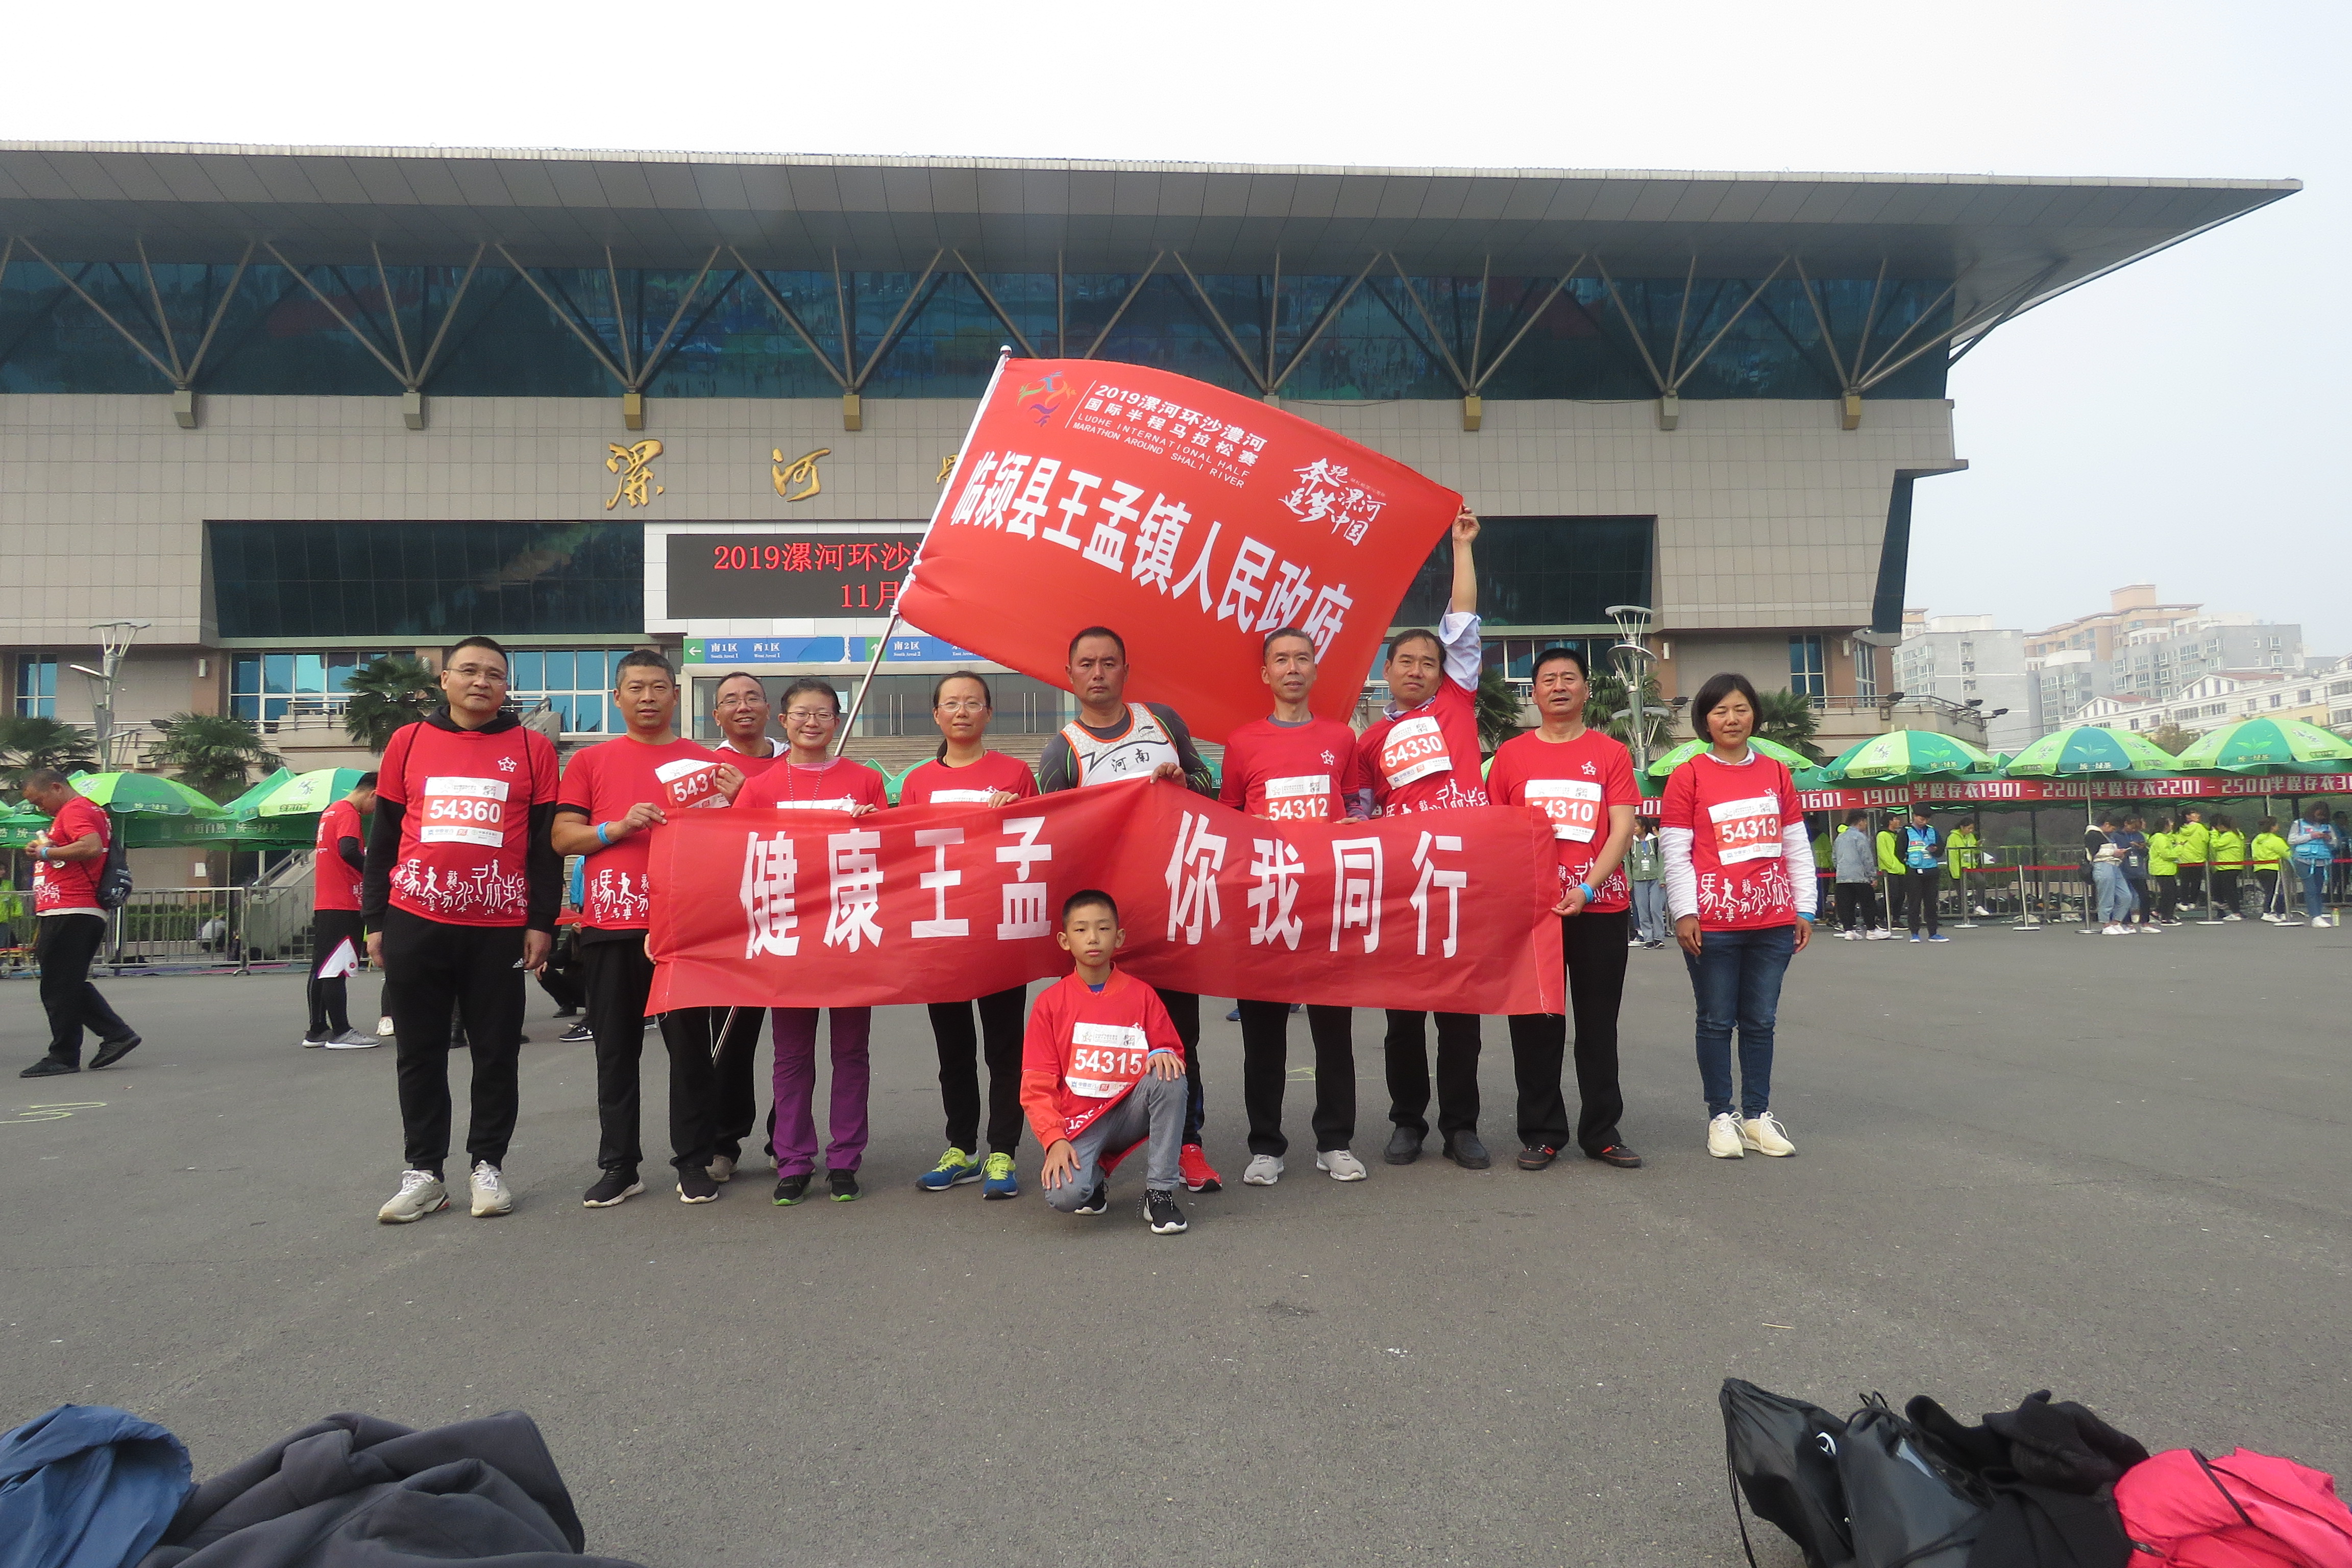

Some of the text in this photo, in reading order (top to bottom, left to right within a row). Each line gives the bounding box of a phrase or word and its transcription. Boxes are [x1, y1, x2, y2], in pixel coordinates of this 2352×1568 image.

[1094, 385, 1267, 452] 2019漯河环沙澧河
[1084, 397, 1259, 467] 国际半程马拉松赛
[1072, 422, 1245, 488] MARATHON AROUND SHALI RIVER
[1077, 413, 1250, 478] LUOHE INTERNATIONAL HALF
[714, 542, 921, 572] 2019漯河环沙
[711, 642, 738, 652] 南1区
[753, 642, 780, 652] 西1区
[894, 641, 920, 650] 南2区
[1111, 748, 1149, 772] 河南
[1384, 735, 1442, 768] 54330
[1268, 797, 1328, 821] 54312
[1863, 788, 1909, 805] 1900
[429, 799, 501, 823] 54360
[1533, 800, 1594, 822] 4310
[1722, 817, 1777, 843] 54313
[739, 810, 1467, 960] 健康王孟 你我同行
[1074, 1048, 1143, 1075] 54315
